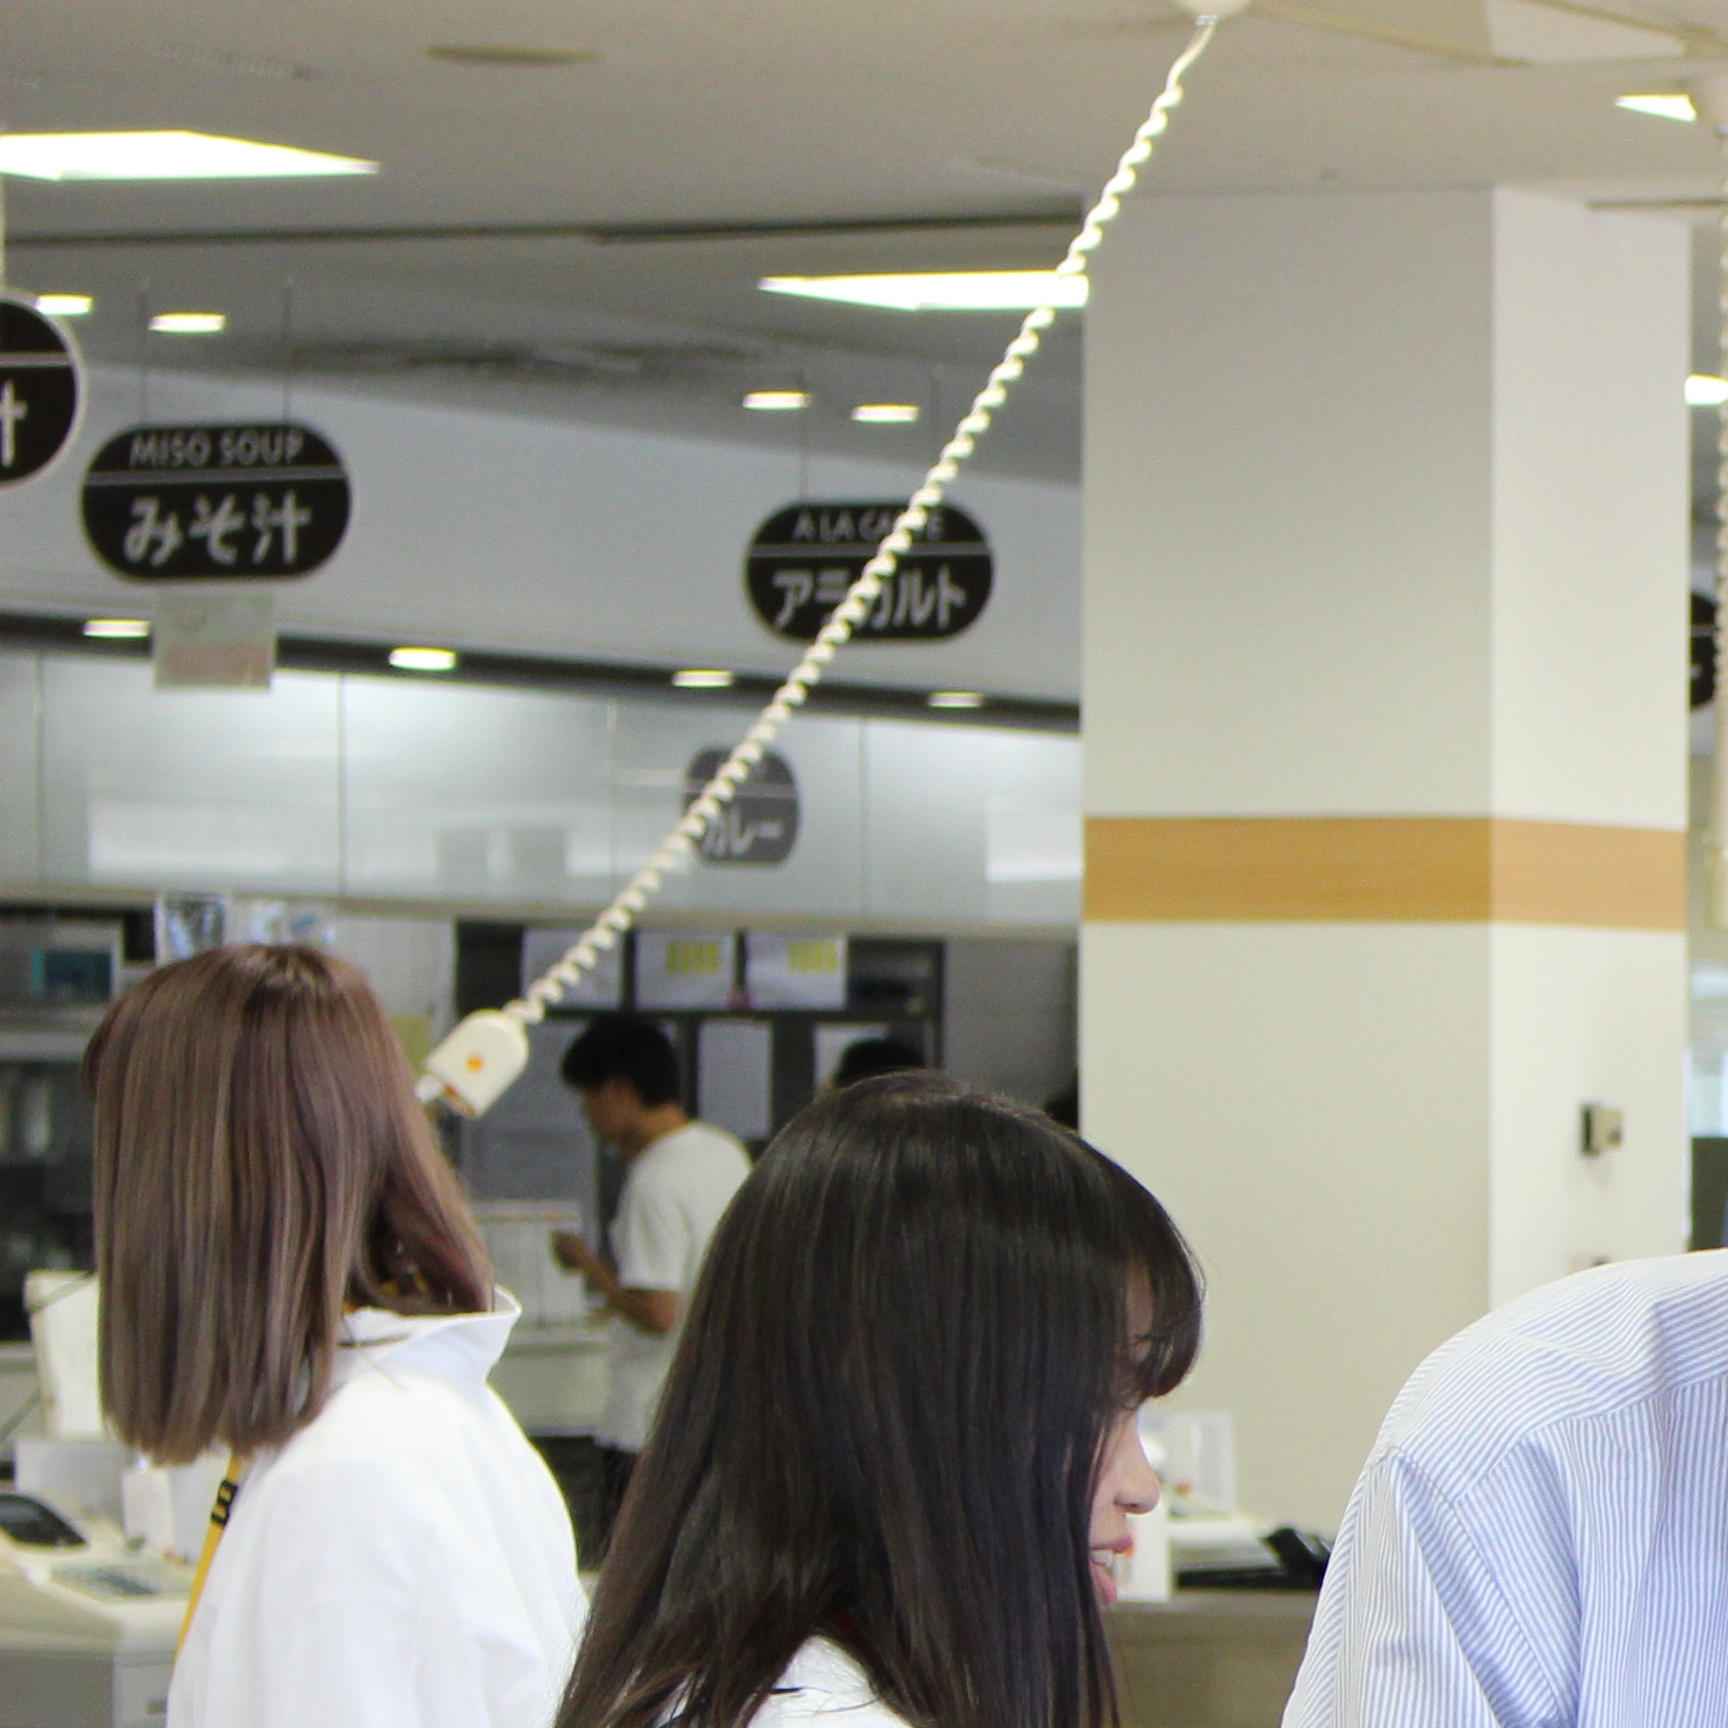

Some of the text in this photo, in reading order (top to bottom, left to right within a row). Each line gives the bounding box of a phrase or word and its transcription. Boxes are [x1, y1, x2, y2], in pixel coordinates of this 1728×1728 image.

[129, 430, 303, 468] MISO SOUP
[124, 489, 312, 568] みそ汁
